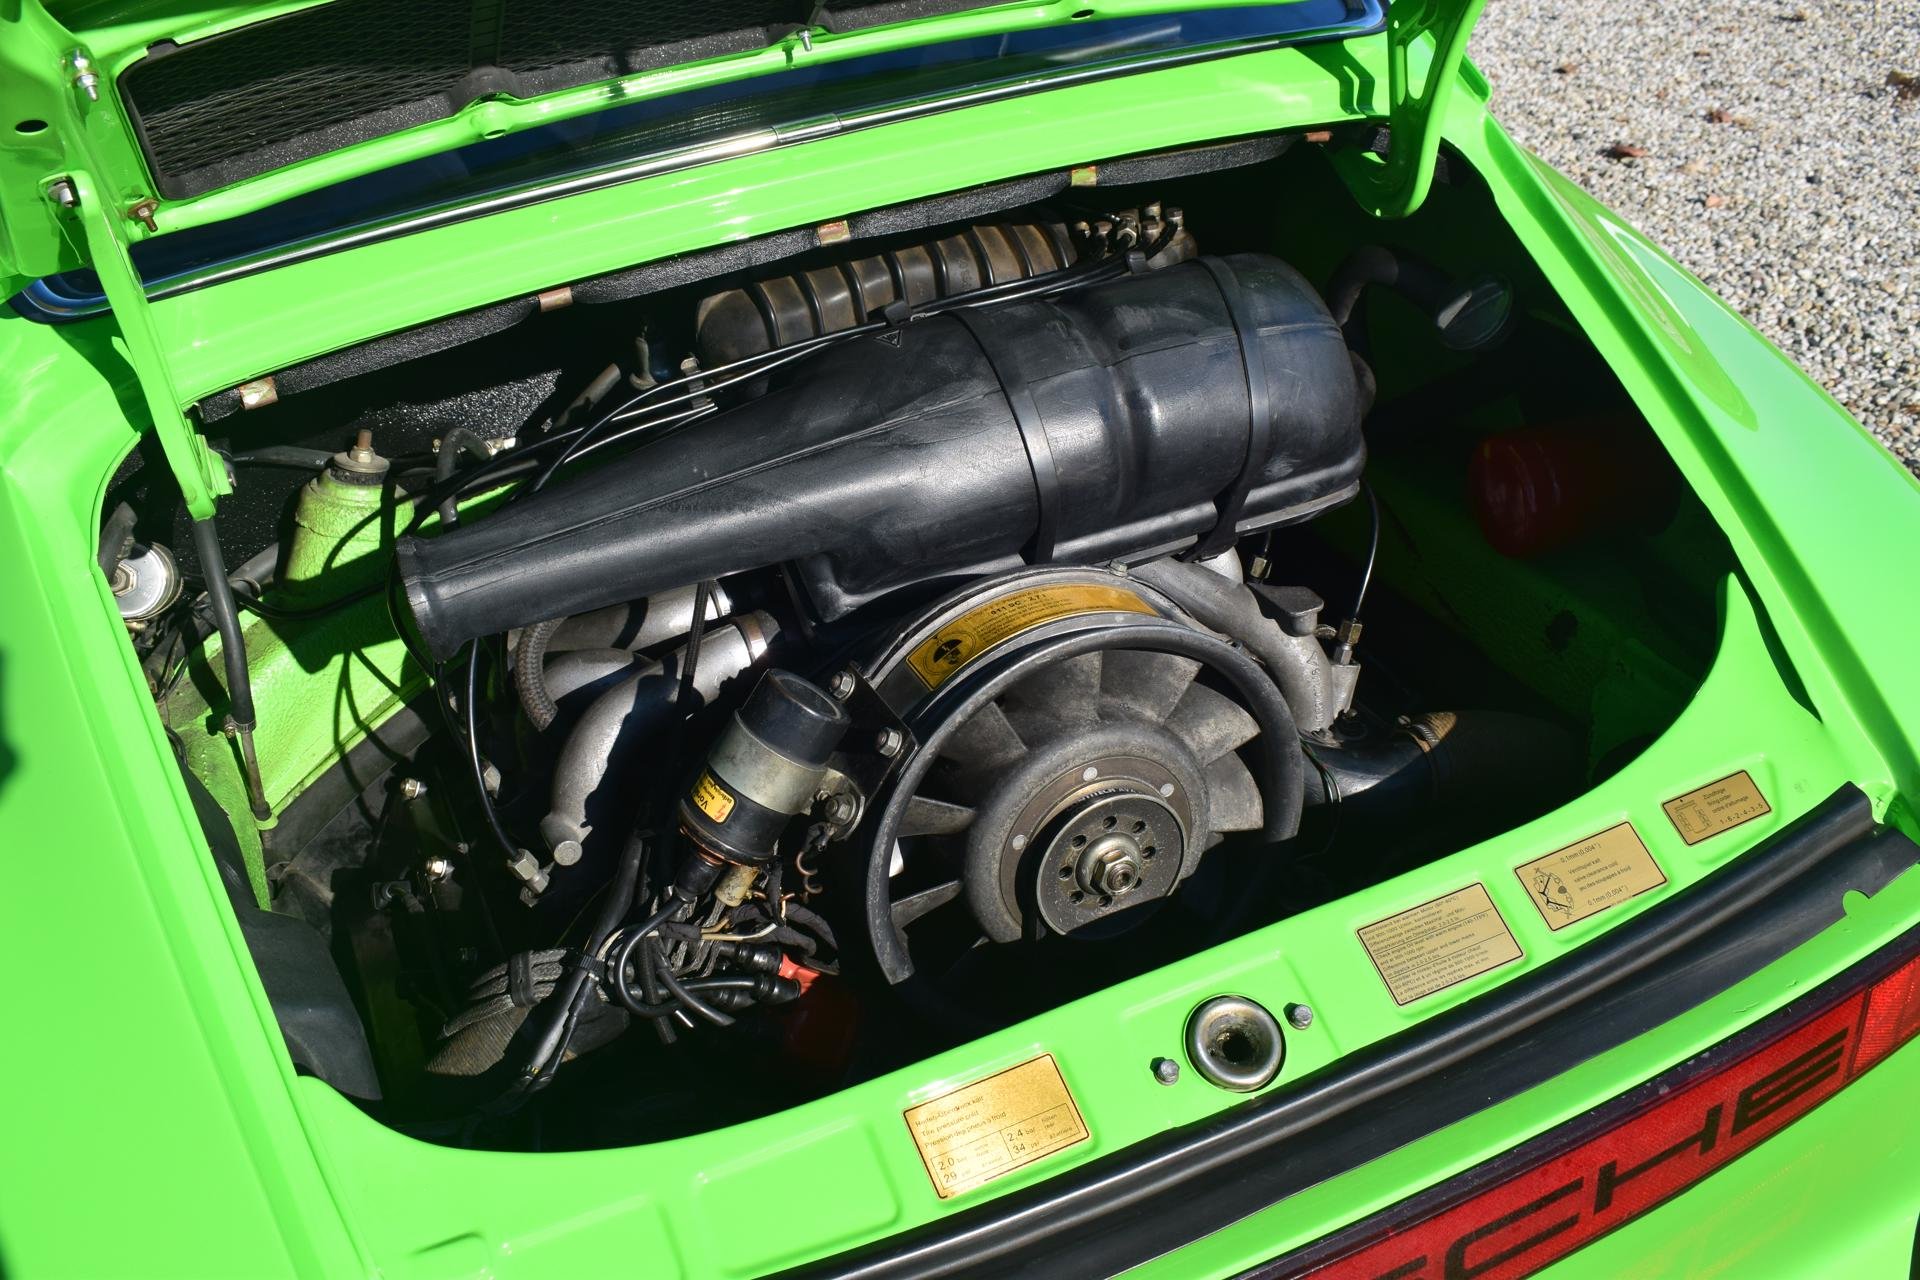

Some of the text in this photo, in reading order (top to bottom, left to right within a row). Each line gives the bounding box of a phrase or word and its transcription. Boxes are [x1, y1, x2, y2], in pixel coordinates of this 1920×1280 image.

[1013, 1143, 1026, 1154] 34
[1371, 1026, 1849, 1280] CHE
[943, 1171, 958, 1183] 29
